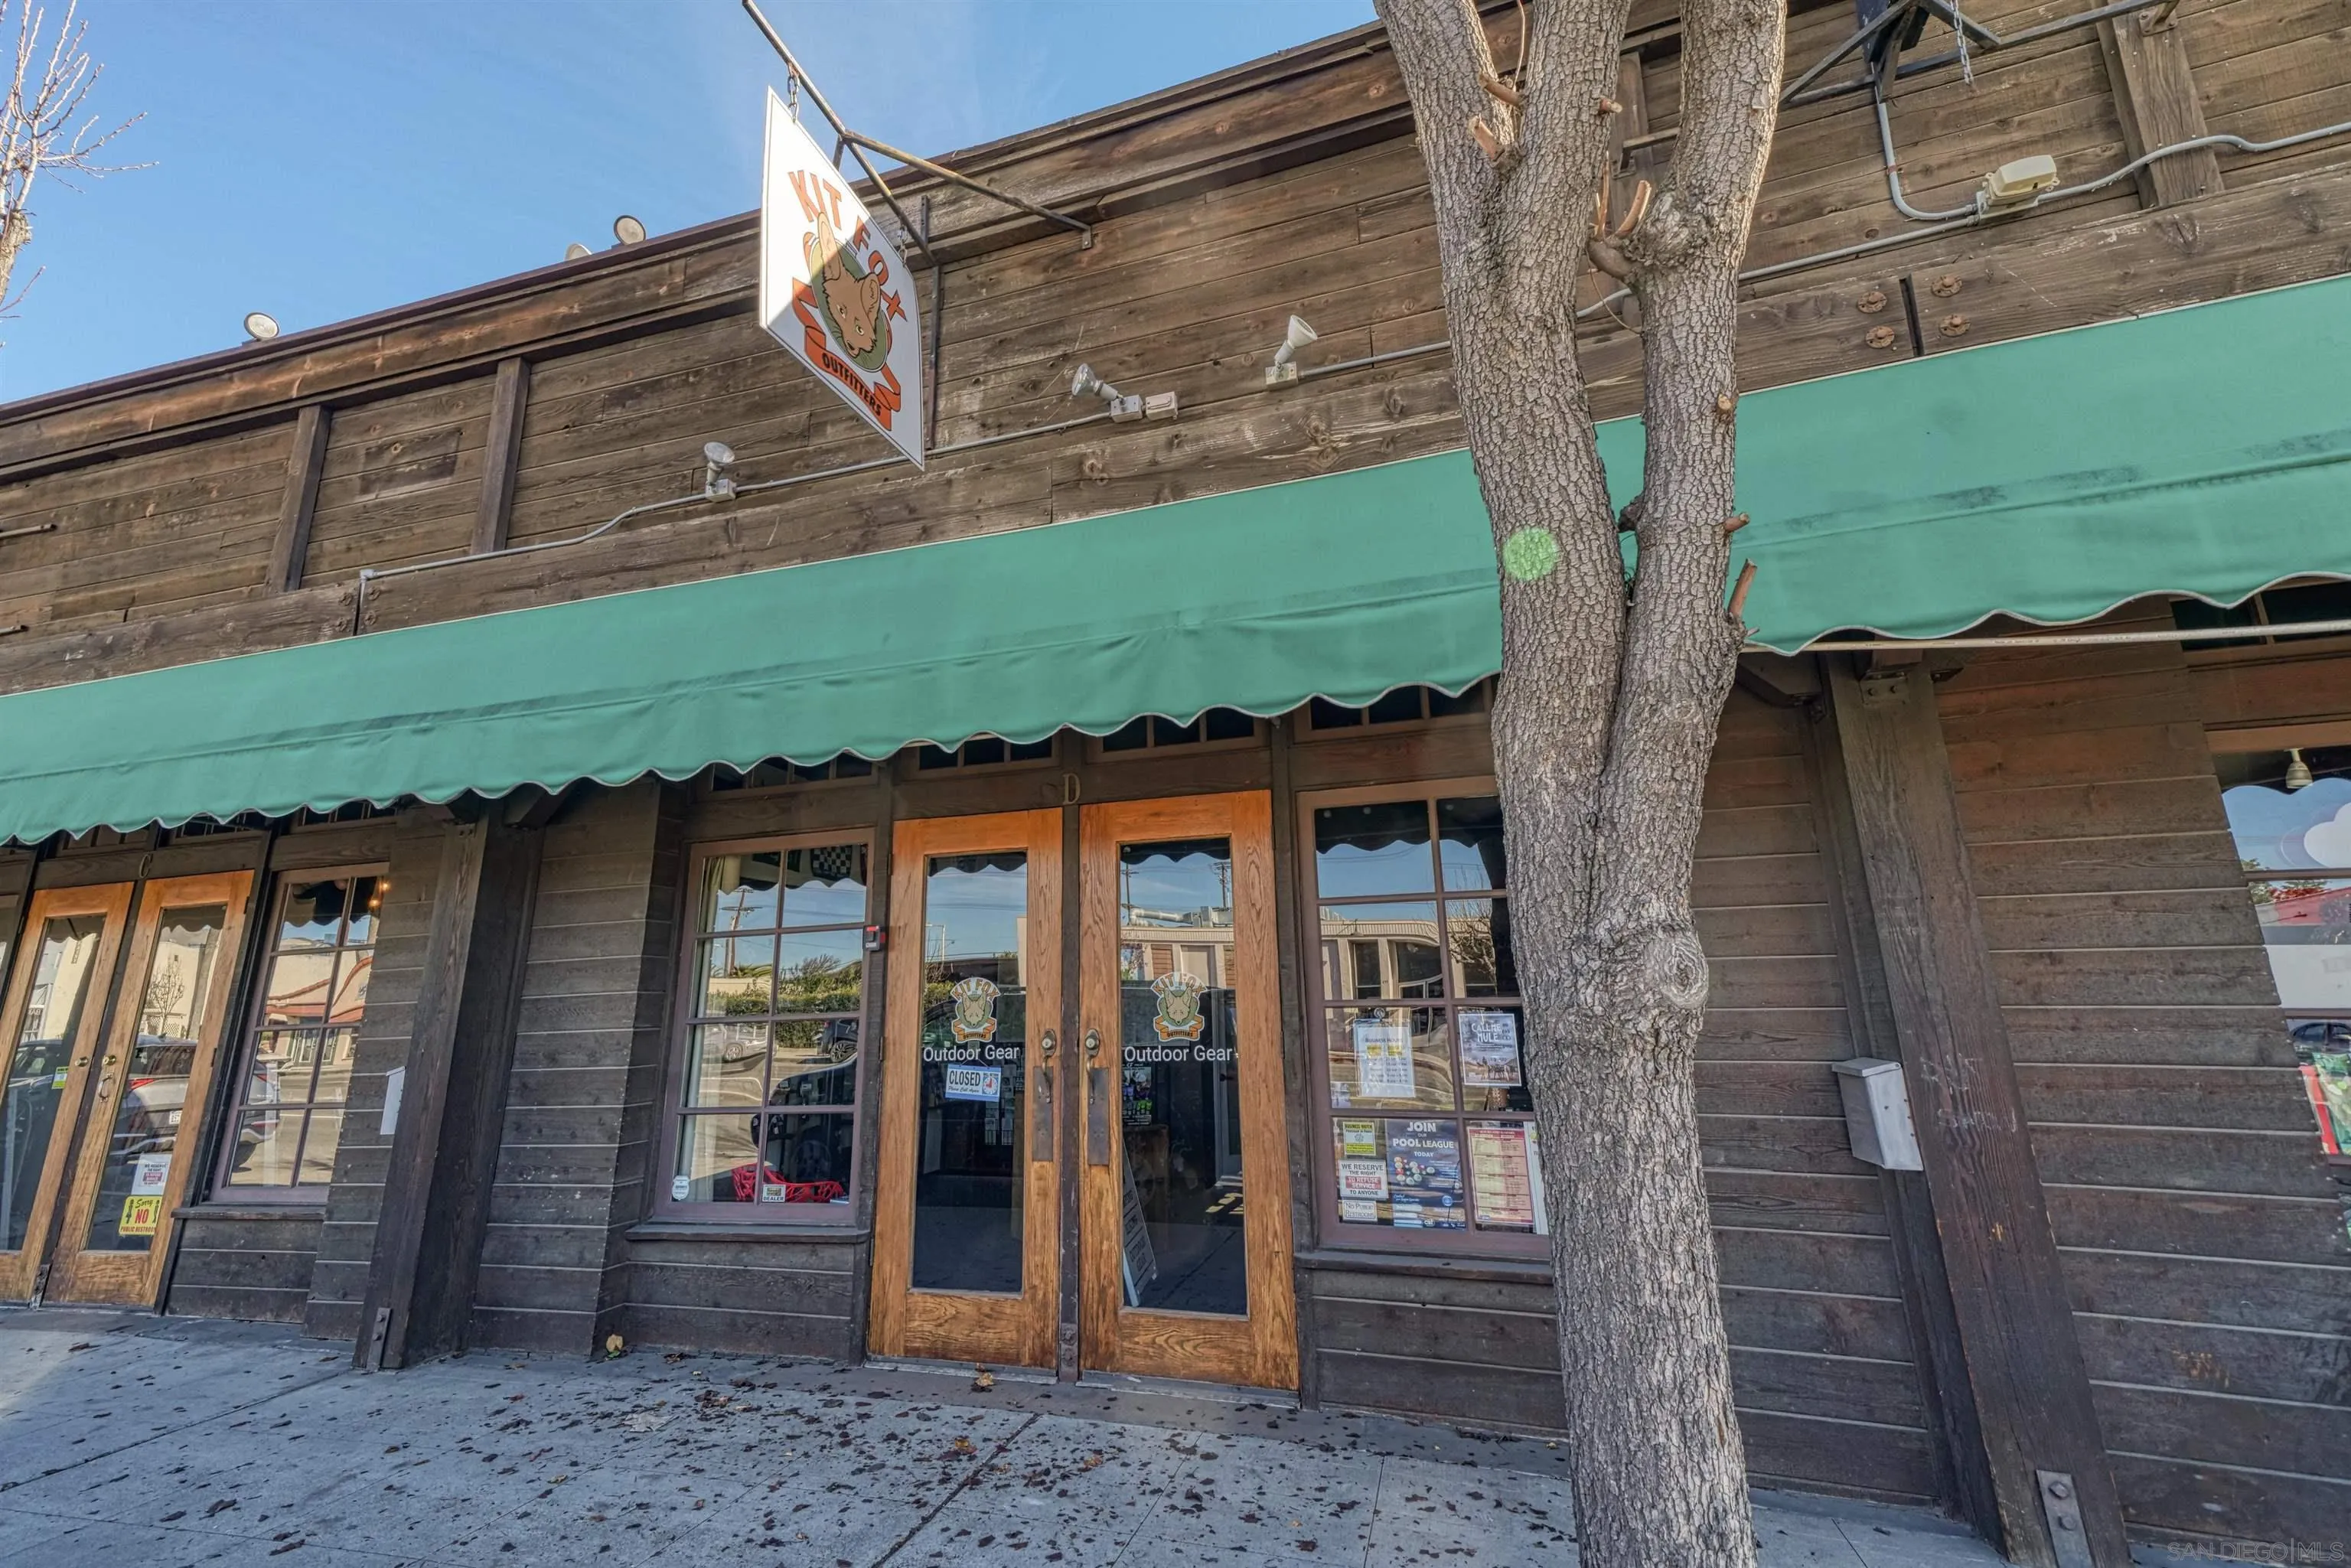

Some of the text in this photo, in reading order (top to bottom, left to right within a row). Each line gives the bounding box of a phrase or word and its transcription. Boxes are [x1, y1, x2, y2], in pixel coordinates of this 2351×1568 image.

[787, 171, 908, 322] KIT FOX
[822, 352, 881, 416] OUTFITTERS
[1063, 774, 1081, 805] D
[139, 853, 152, 879] C
[952, 979, 998, 1001] KIT FOX
[1154, 973, 1206, 996] KIT FOX
[1478, 1032, 1498, 1042] MULE
[923, 1045, 1019, 1062] Outdoor Gear
[1124, 1045, 1233, 1062] Outdoor Gear
[949, 1071, 980, 1087] CLOSED
[1407, 1121, 1436, 1133] JOIN
[1393, 1138, 1454, 1149] POOL LEAGUE
[135, 1198, 154, 1208] Sorry
[134, 1208, 149, 1224] NO
